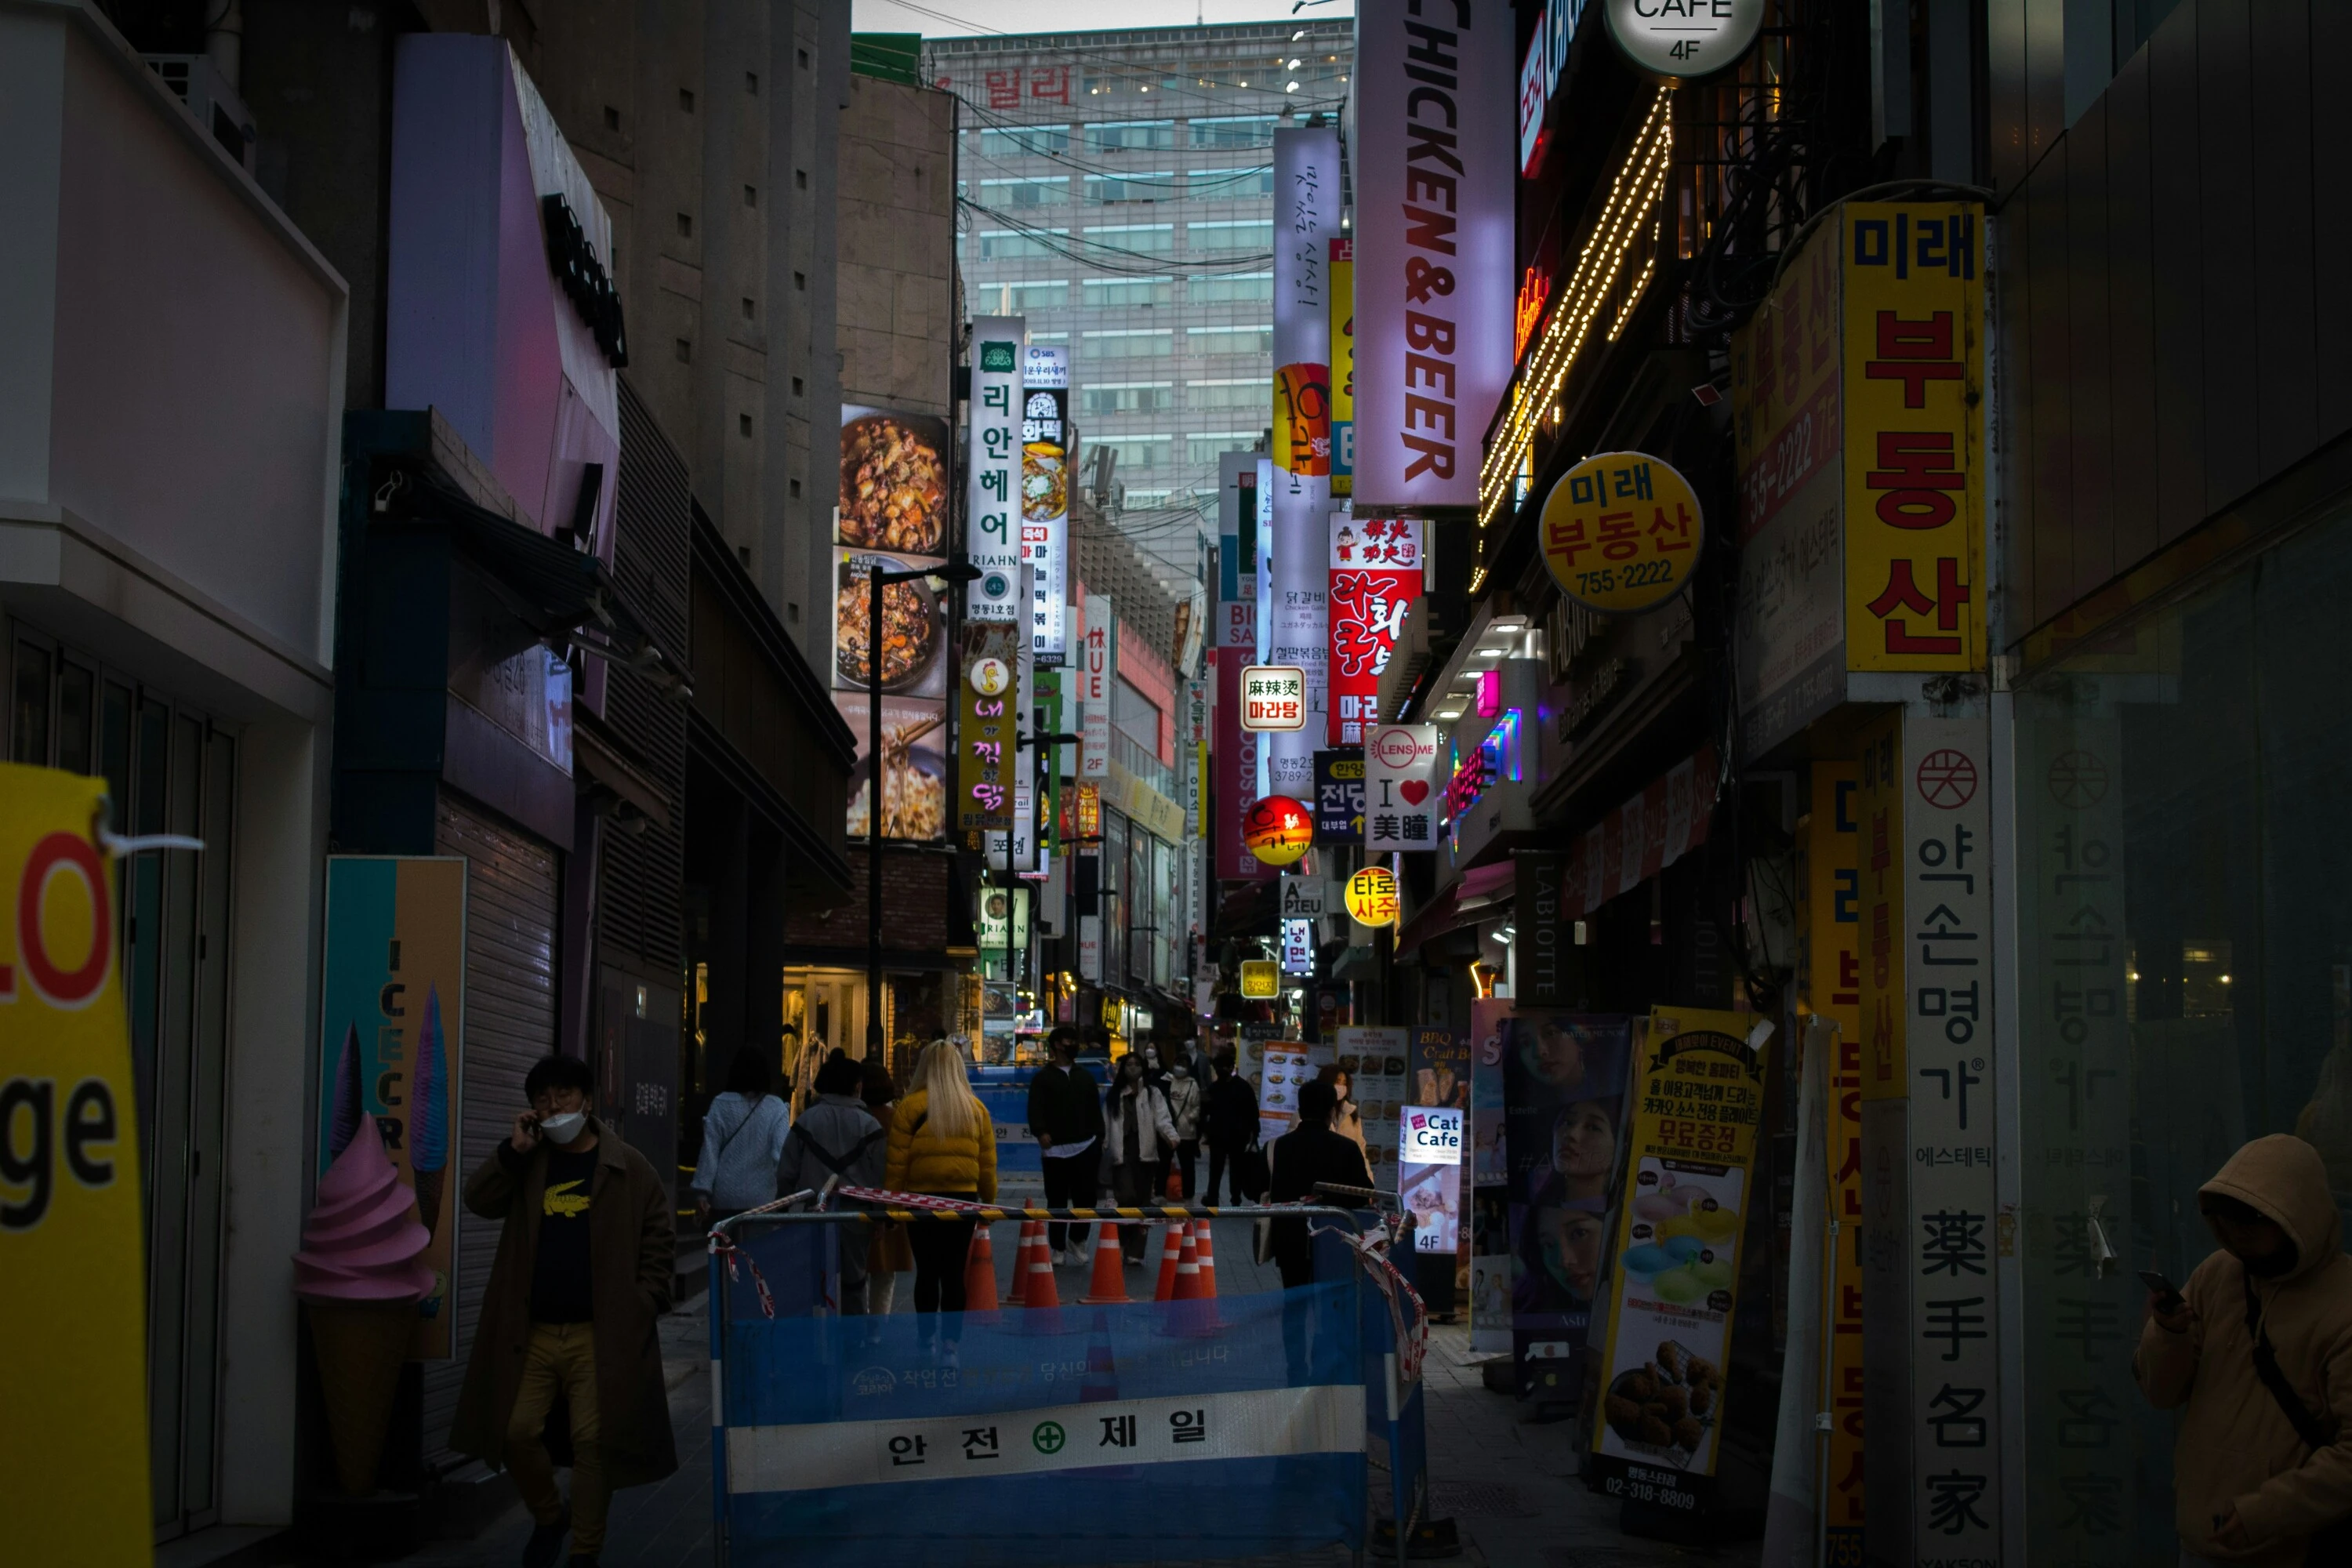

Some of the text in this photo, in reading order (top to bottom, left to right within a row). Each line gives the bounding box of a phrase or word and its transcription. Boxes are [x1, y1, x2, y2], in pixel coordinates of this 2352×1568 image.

[1635, 0, 1732, 17] CAFE
[1669, 40, 1700, 60] 4F
[1854, 213, 1974, 280] 미래
[980, 385, 1013, 545] 리안헤어
[1744, 412, 1813, 525] 55-2222
[1570, 463, 1653, 508] 미래
[1865, 310, 1969, 655] 부동산
[1547, 503, 1692, 568] 부동산
[974, 555, 1017, 565] RIAHN
[1576, 559, 1674, 596] 755-2222
[1035, 546, 1047, 648] 마늘떡볶이
[1287, 592, 1325, 604] 닭갈비
[972, 604, 1014, 615] 명동1호점
[1231, 605, 1256, 626] BI
[1230, 629, 1255, 644] SA
[1249, 680, 1298, 696] 麻辣烫
[1249, 702, 1298, 719] 마라탕
[1240, 731, 1256, 791] OODS
[1382, 745, 1433, 755] LENS ME
[1087, 759, 1103, 770] 2F
[1275, 771, 1313, 782] 3789-2
[1380, 779, 1393, 808] I
[1322, 820, 1347, 831] 대부업
[1374, 814, 1428, 840] 美瞳
[1354, 876, 1395, 895] 타로
[1285, 899, 1321, 913] PIEU
[1355, 897, 1396, 919] 사주
[0, 831, 111, 1004] O
[988, 924, 1025, 933] RIAN
[1535, 865, 1555, 996] LABIOTTE
[1290, 927, 1306, 963] 냉면
[1917, 824, 1980, 1130] 약손명가
[378, 939, 406, 1152] ICECR
[1420, 1032, 1452, 1046] BBQ
[1711, 1035, 1742, 1056] EVENT
[1423, 1046, 1455, 1060] Craft
[1643, 1097, 1675, 1116] 카카오
[1676, 1101, 1695, 1119] 소스
[1697, 1103, 1717, 1122] 전용
[1428, 1115, 1459, 1131] Cat
[1417, 1131, 1459, 1147] Cafe
[1657, 1119, 1736, 1153] 무료증정
[1916, 1146, 1991, 1168] 에스테틱
[1420, 1235, 1439, 1250] 4F
[902, 1369, 957, 1388] 작업전
[1041, 1359, 1093, 1382] 당신의
[888, 1409, 1206, 1466] 안전 제일
[1628, 1465, 1678, 1488] 명동스타점
[1606, 1476, 1696, 1511] 02-318-8809
